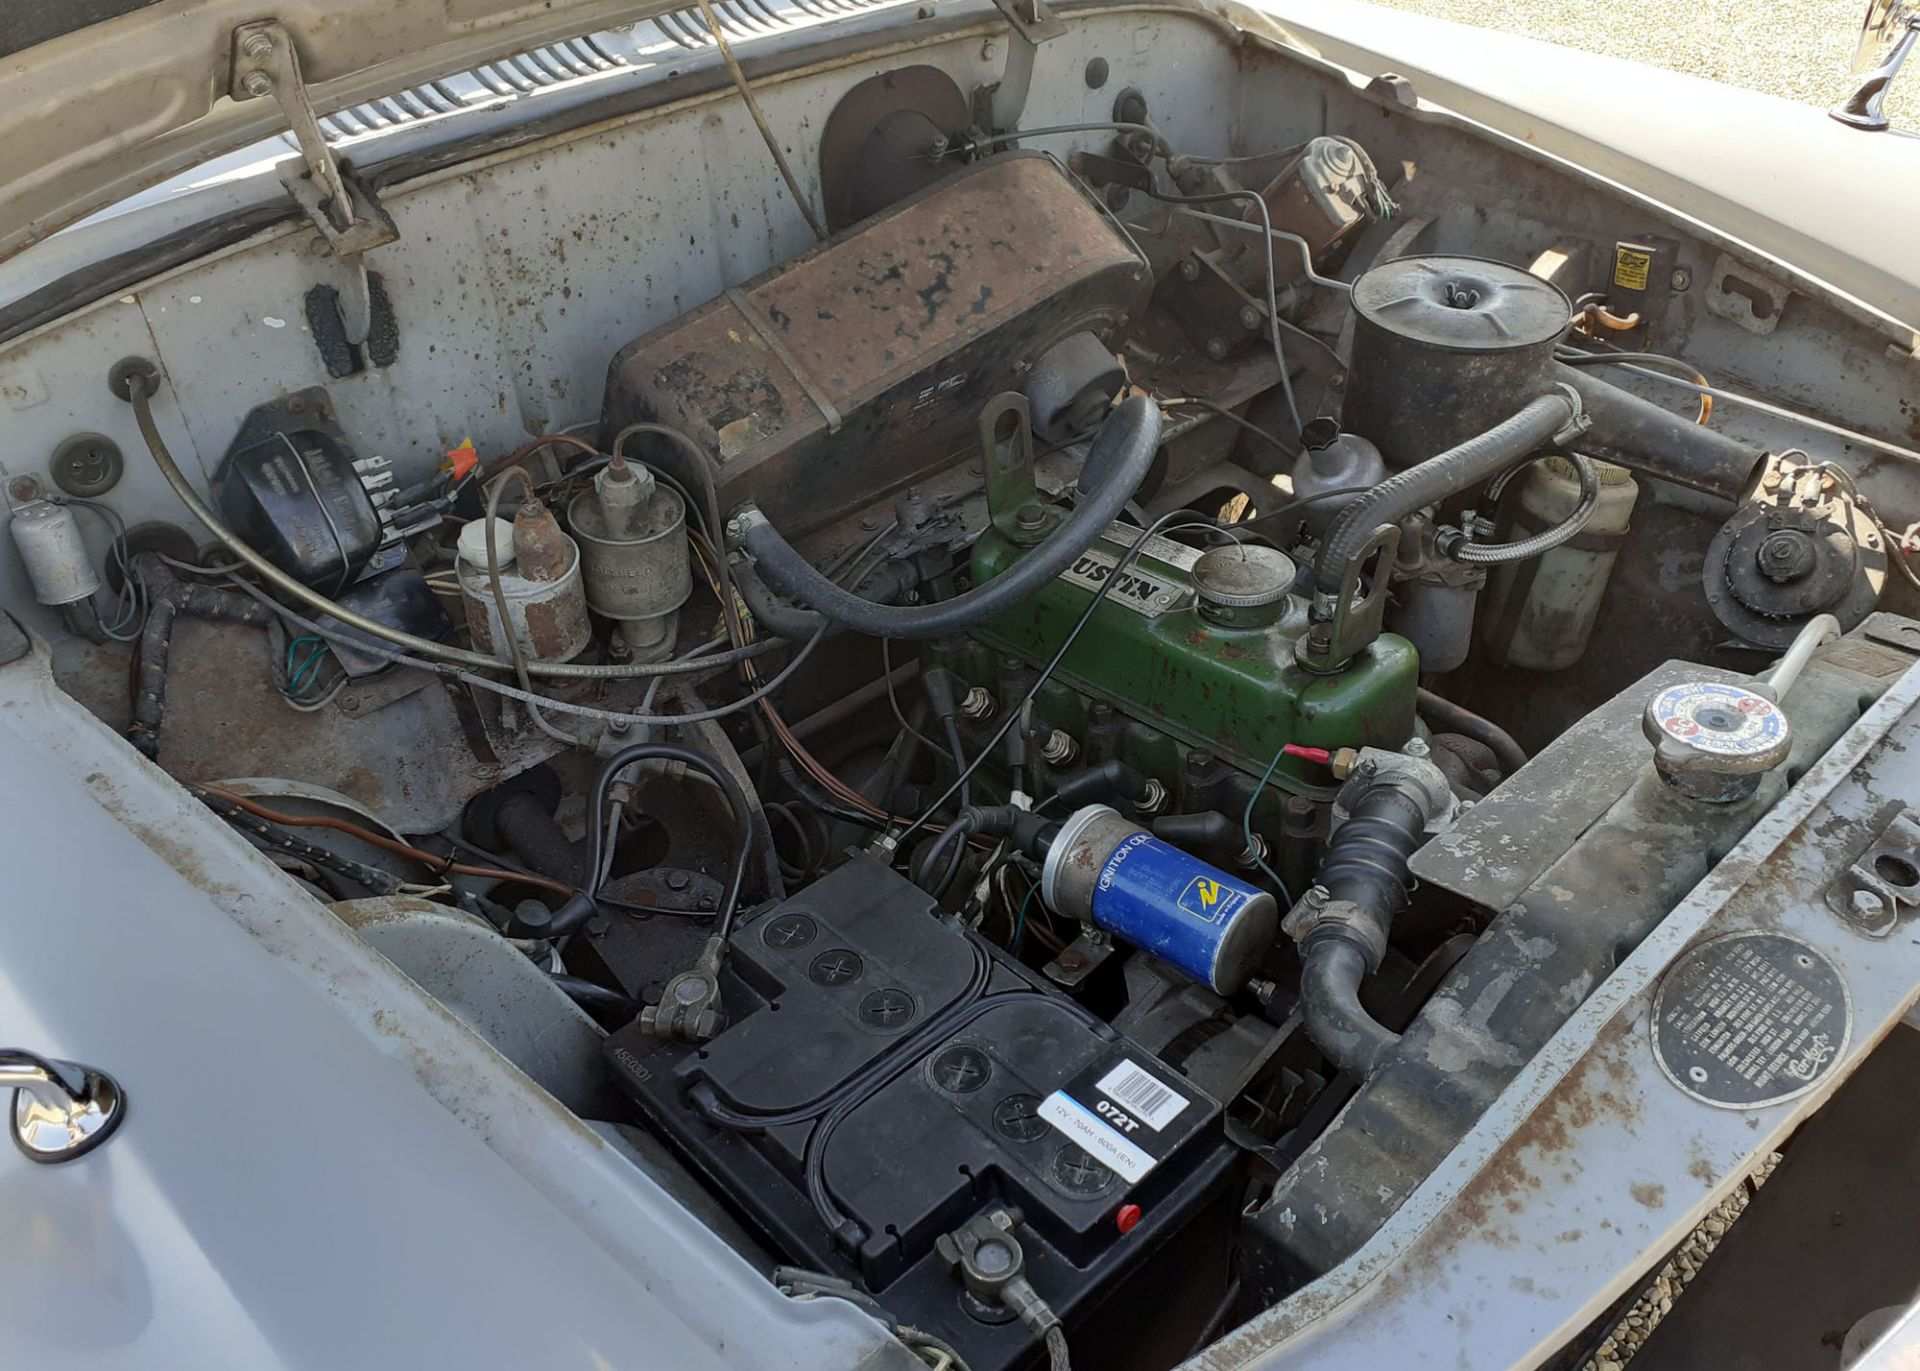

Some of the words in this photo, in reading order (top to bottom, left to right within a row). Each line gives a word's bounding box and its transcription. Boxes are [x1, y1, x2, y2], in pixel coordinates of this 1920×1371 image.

[1071, 556, 1160, 601] USTIN
[1098, 844, 1133, 892] IGNITION
[1753, 1070, 1772, 1088] NIGHT
[1767, 1051, 1790, 1073] SERVICE
[1055, 1104, 1070, 1118] 12V
[1073, 1119, 1095, 1136] 70AH
[1097, 1137, 1118, 1154] 600A
[1116, 1151, 1136, 1169] (EN)
[1095, 1100, 1140, 1133] 072T
